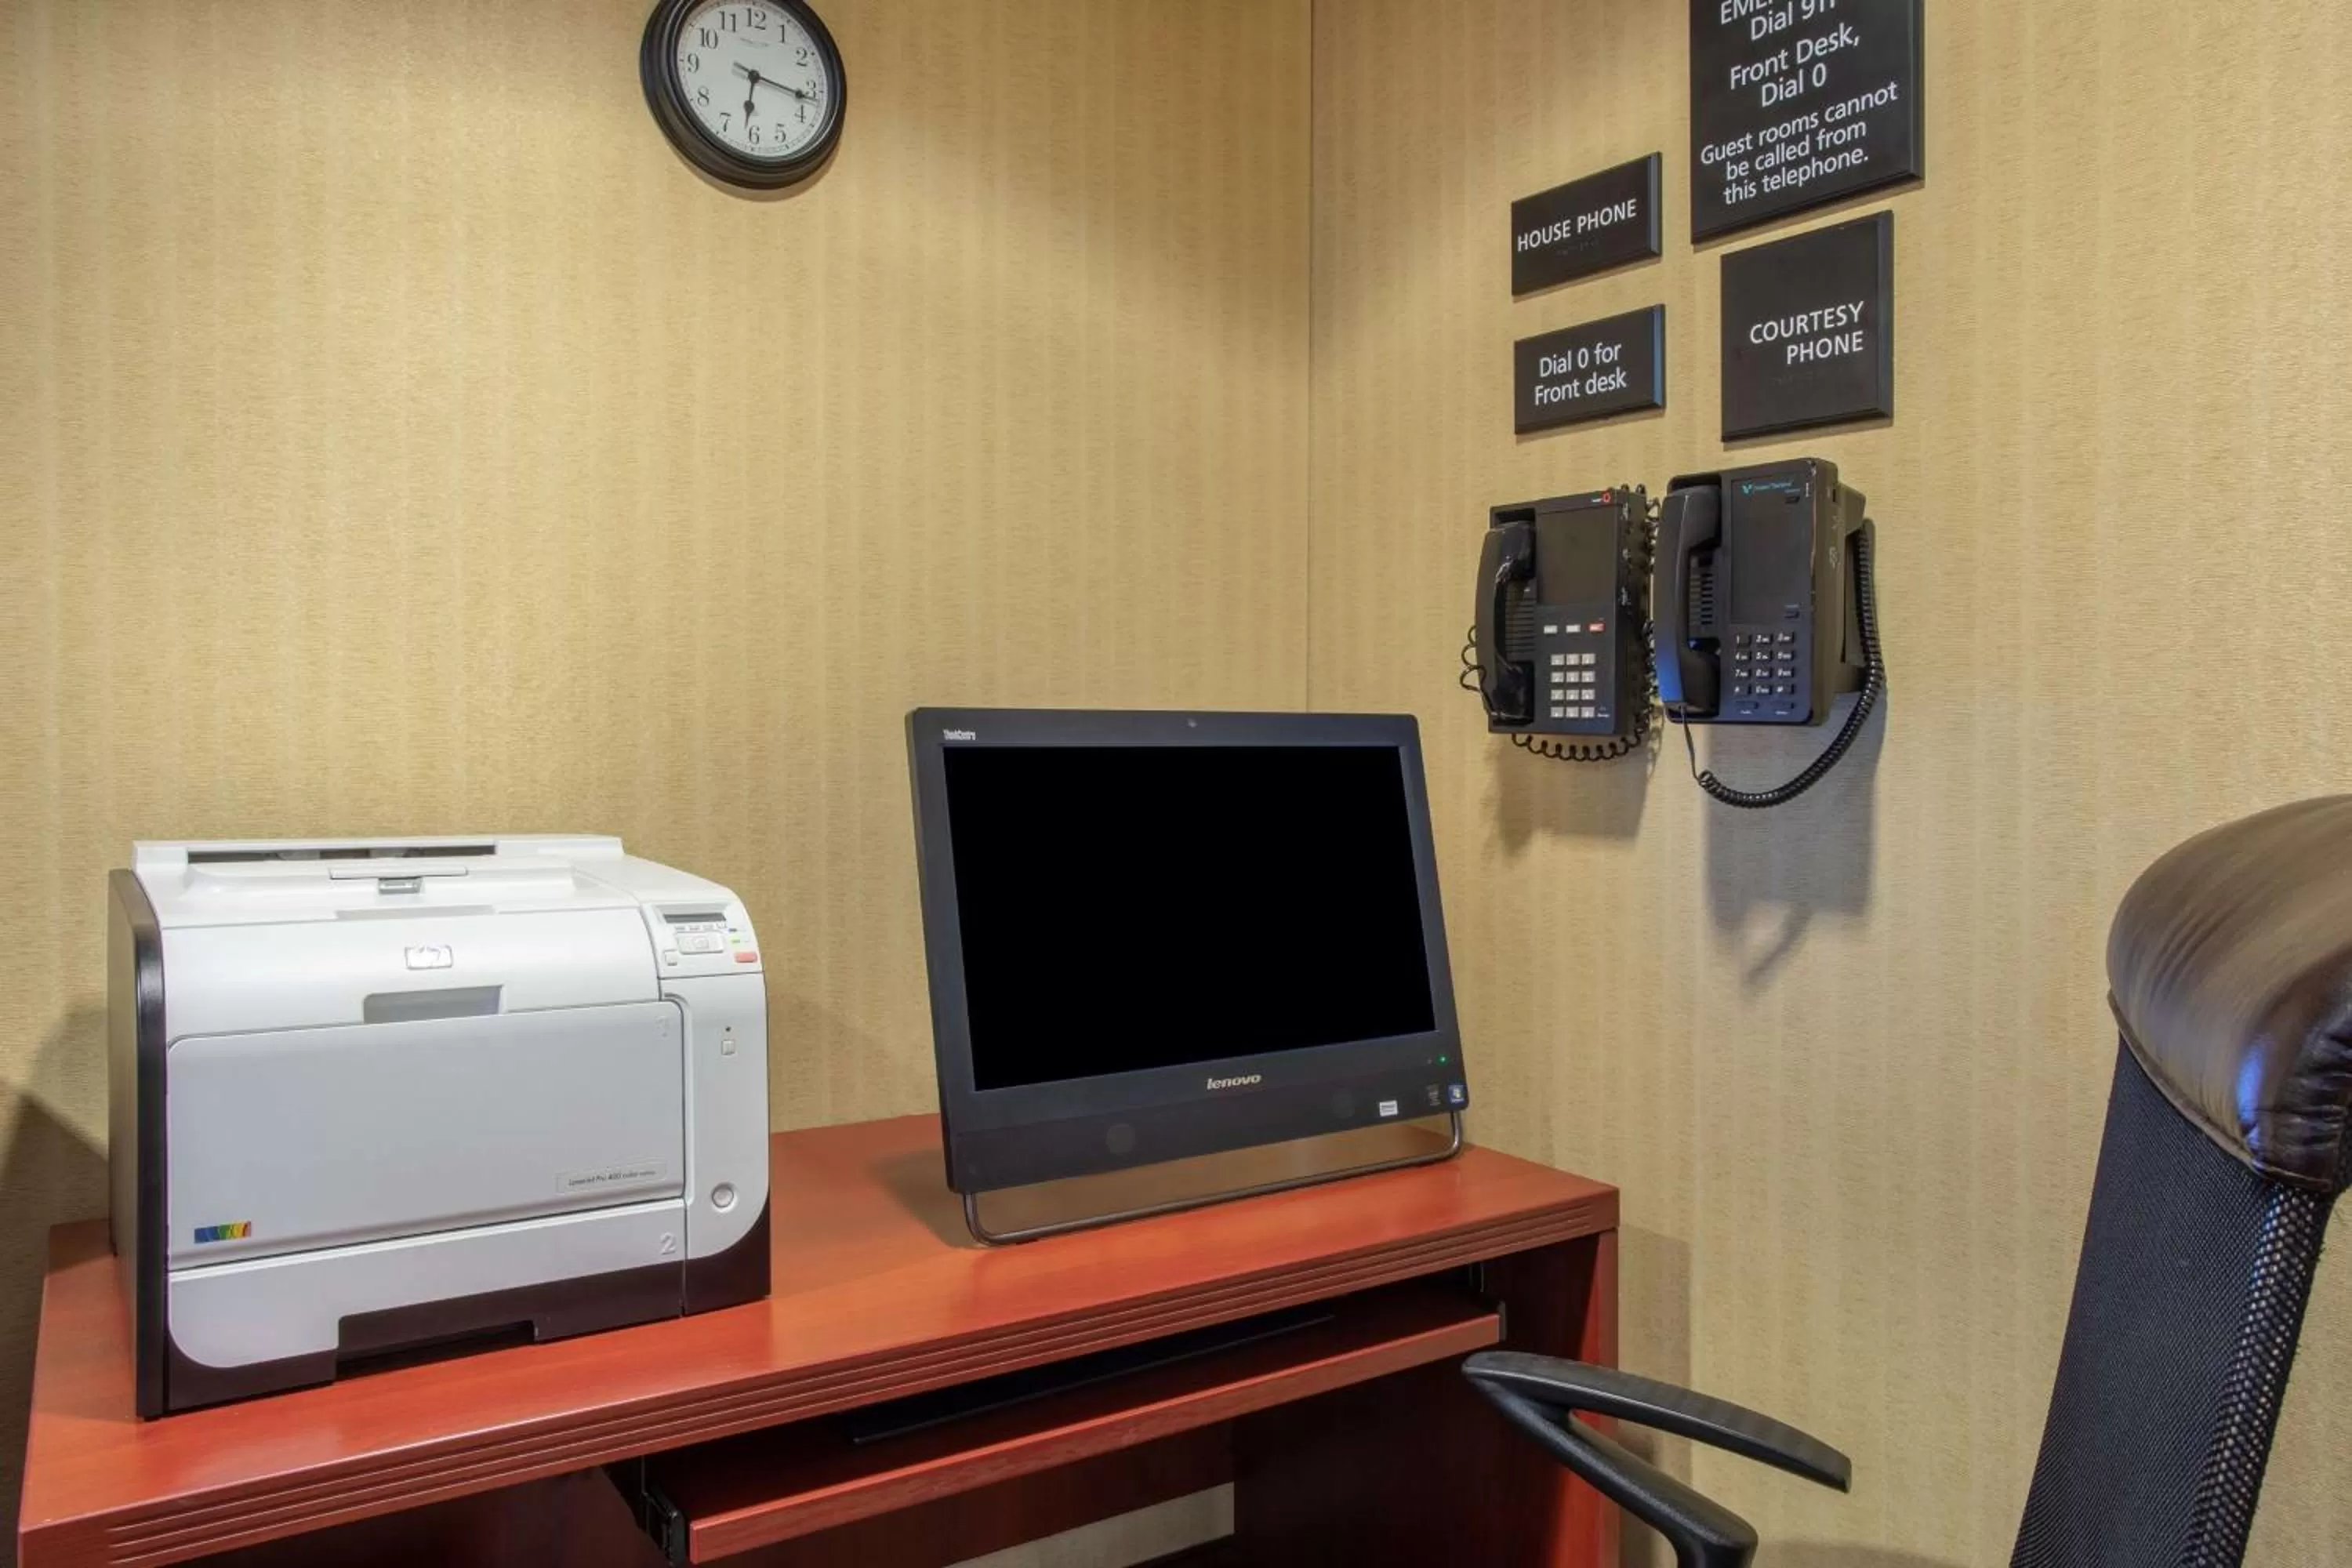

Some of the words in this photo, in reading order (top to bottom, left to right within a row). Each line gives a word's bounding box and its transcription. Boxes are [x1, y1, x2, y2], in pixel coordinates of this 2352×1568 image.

[719, 11, 737, 32] 11
[746, 8, 766, 30] 12
[1751, 1, 1793, 41] Dial
[699, 27, 719, 49] 10
[779, 24, 786, 44] 1
[687, 53, 699, 73] 9
[796, 47, 808, 67] 2
[1730, 49, 1788, 90] Front
[1796, 22, 1860, 64] Desk,
[1761, 70, 1803, 107] Dial
[1812, 63, 1827, 87] 0
[697, 86, 710, 107] 8
[719, 112, 731, 132] 7
[794, 104, 804, 123] 4
[1700, 132, 1753, 165] Guest
[1759, 111, 1819, 147] rooms
[1824, 81, 1899, 122] cannot
[749, 125, 760, 144] 6
[775, 123, 786, 143] 5
[1726, 160, 1755, 181] be
[1755, 135, 1809, 168] called
[1816, 121, 1867, 151] from
[1723, 180, 1757, 205] this
[1762, 147, 1869, 193] telephone.
[1517, 219, 1572, 252] HOUSE
[1577, 198, 1637, 234] PHONE
[1749, 300, 1864, 344] COURTESY
[1787, 330, 1864, 365] PHONE
[1539, 350, 1572, 377] Dial
[1577, 347, 1589, 368] 0
[1594, 342, 1622, 365] for
[1534, 379, 1581, 406] Front
[1585, 366, 1627, 395] desk
[1207, 1074, 1261, 1090] lenovo
[661, 1232, 677, 1255] 2
